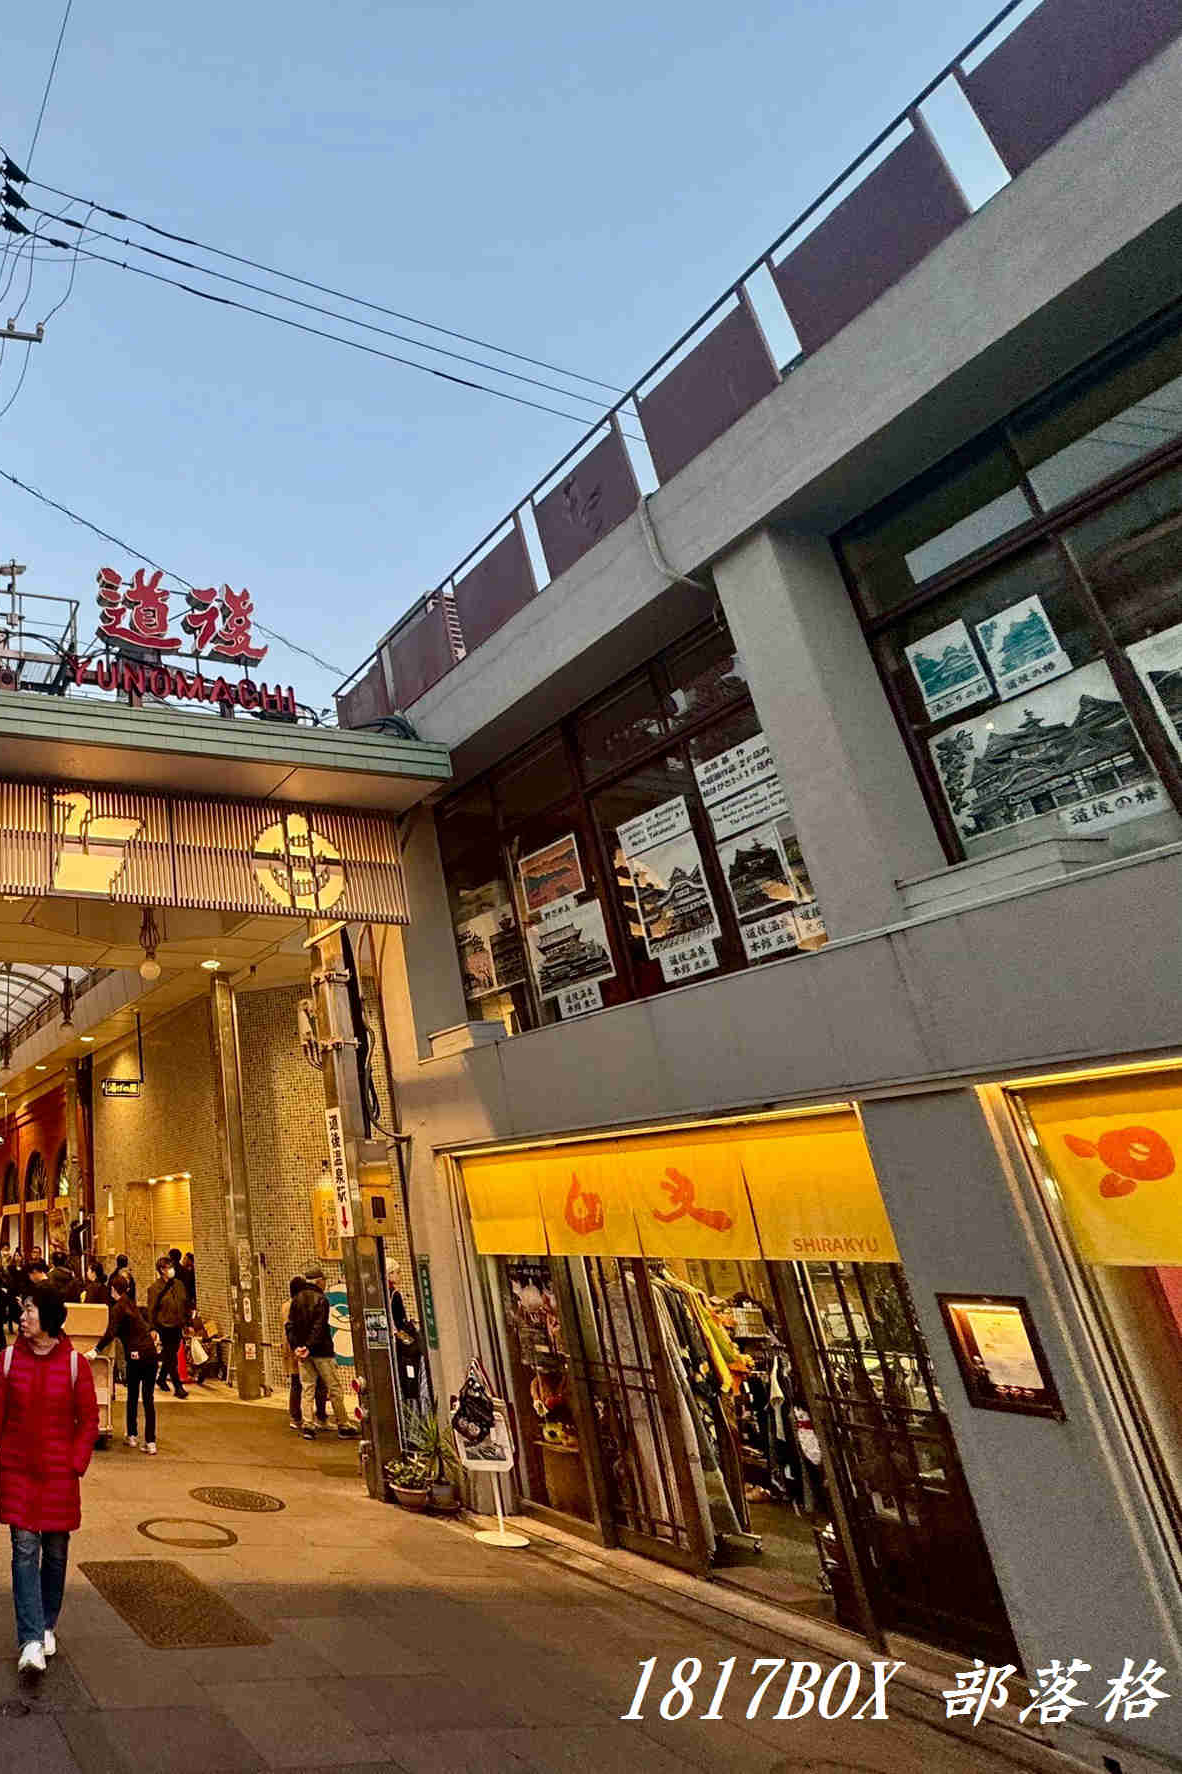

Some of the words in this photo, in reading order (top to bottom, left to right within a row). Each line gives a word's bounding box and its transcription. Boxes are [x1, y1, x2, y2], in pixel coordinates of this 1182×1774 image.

[95, 566, 269, 668] 道後
[67, 652, 297, 717] YUNOMACHI
[792, 1237, 880, 1253] SHIRAKYU
